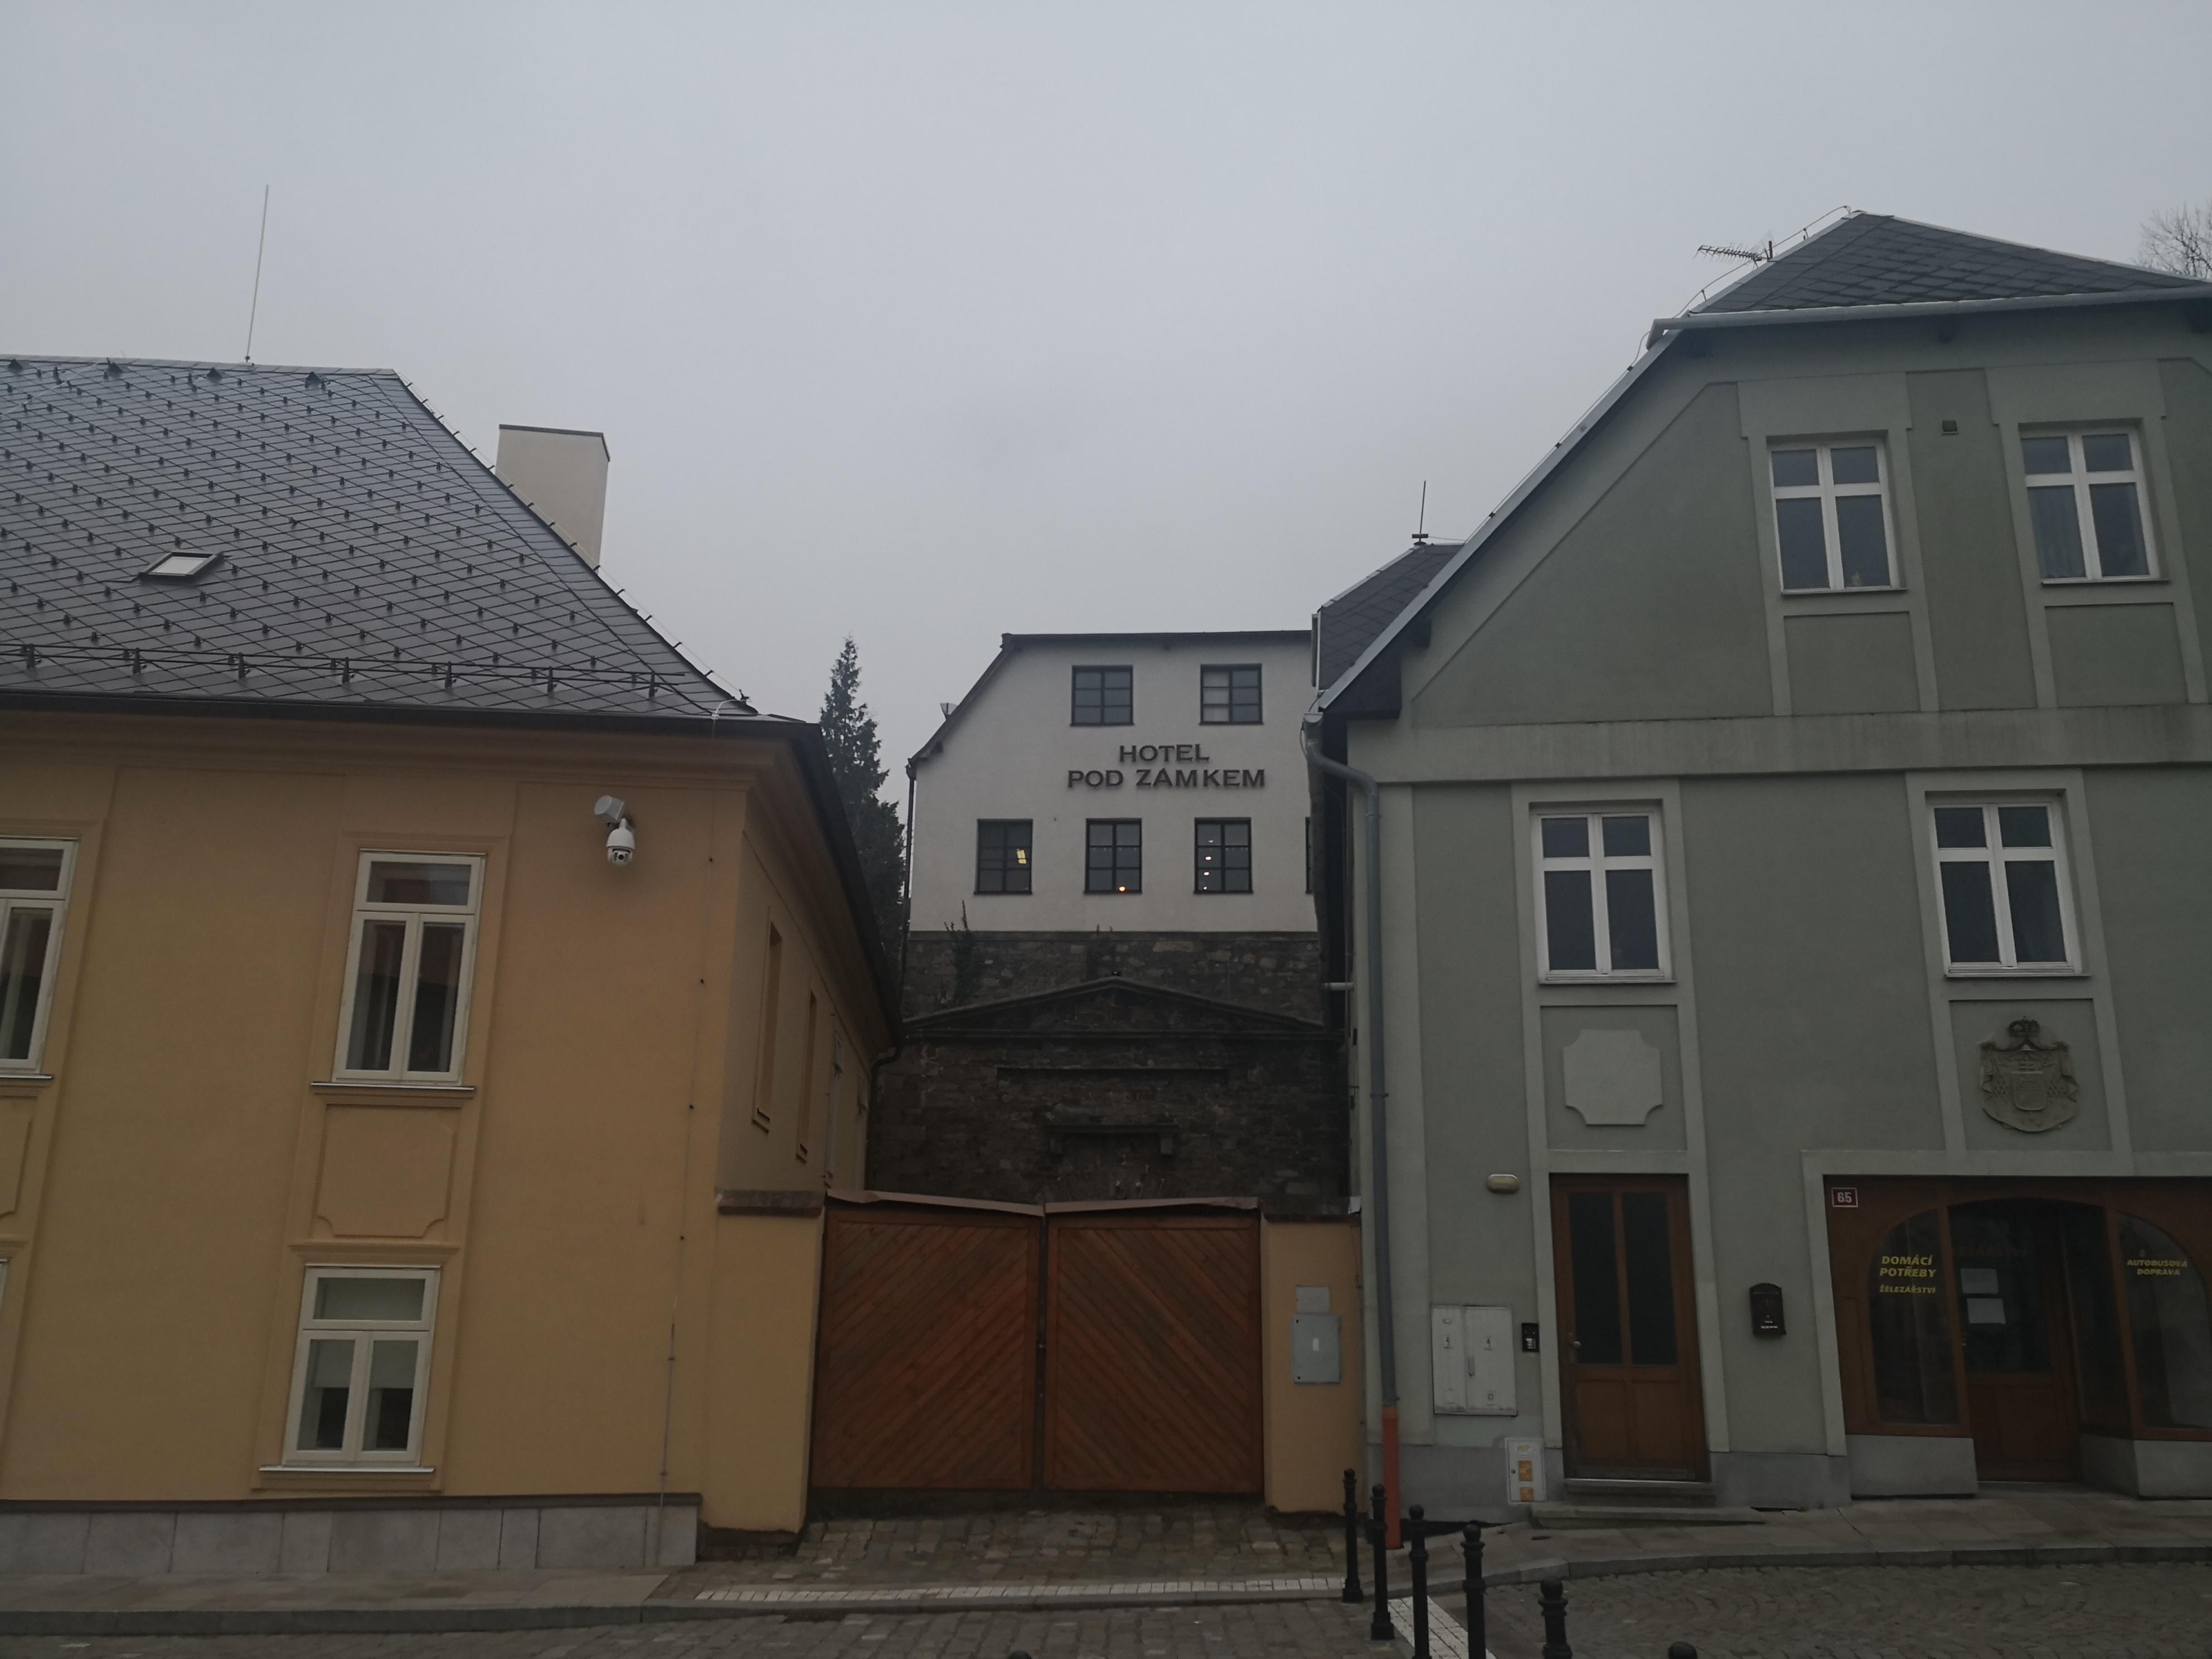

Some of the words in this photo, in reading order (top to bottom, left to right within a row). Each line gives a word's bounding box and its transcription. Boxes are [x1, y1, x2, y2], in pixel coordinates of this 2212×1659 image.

[1119, 744, 1210, 762] HOTEL
[1068, 770, 1124, 788] POD
[1837, 1192, 1852, 1203] 65
[1881, 1254, 1933, 1265] DOMÁCÍ
[1879, 1266, 1937, 1277] POTŘEBY
[1879, 1284, 1936, 1293] ŽELEZÁŘSTVÍ
